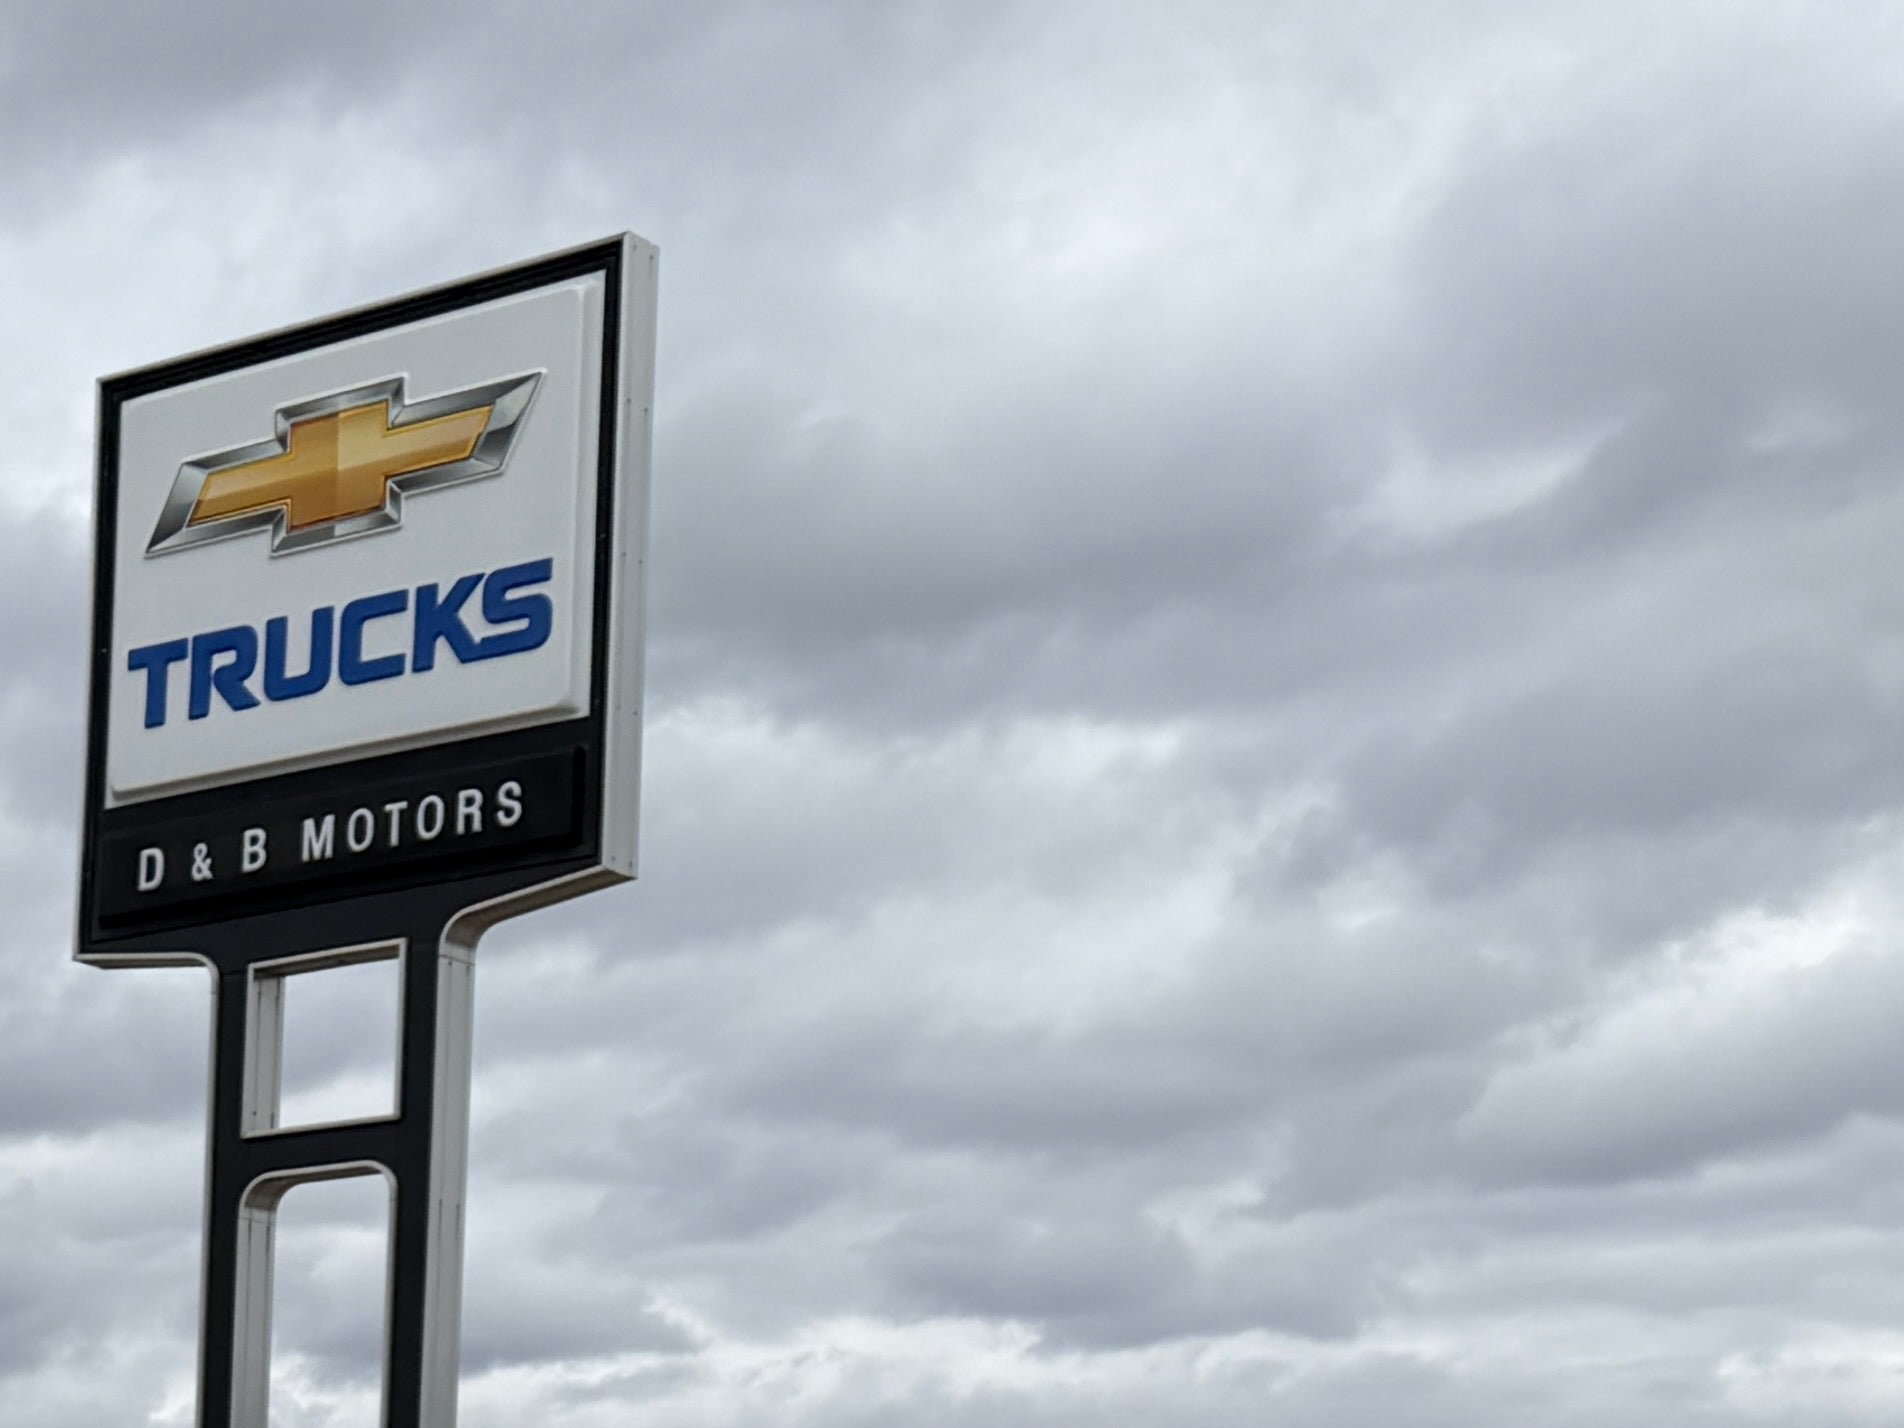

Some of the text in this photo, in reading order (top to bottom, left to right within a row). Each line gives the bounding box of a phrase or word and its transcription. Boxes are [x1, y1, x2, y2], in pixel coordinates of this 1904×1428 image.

[128, 558, 553, 729] TRUCKS
[137, 781, 523, 892] D & B MOTORS
